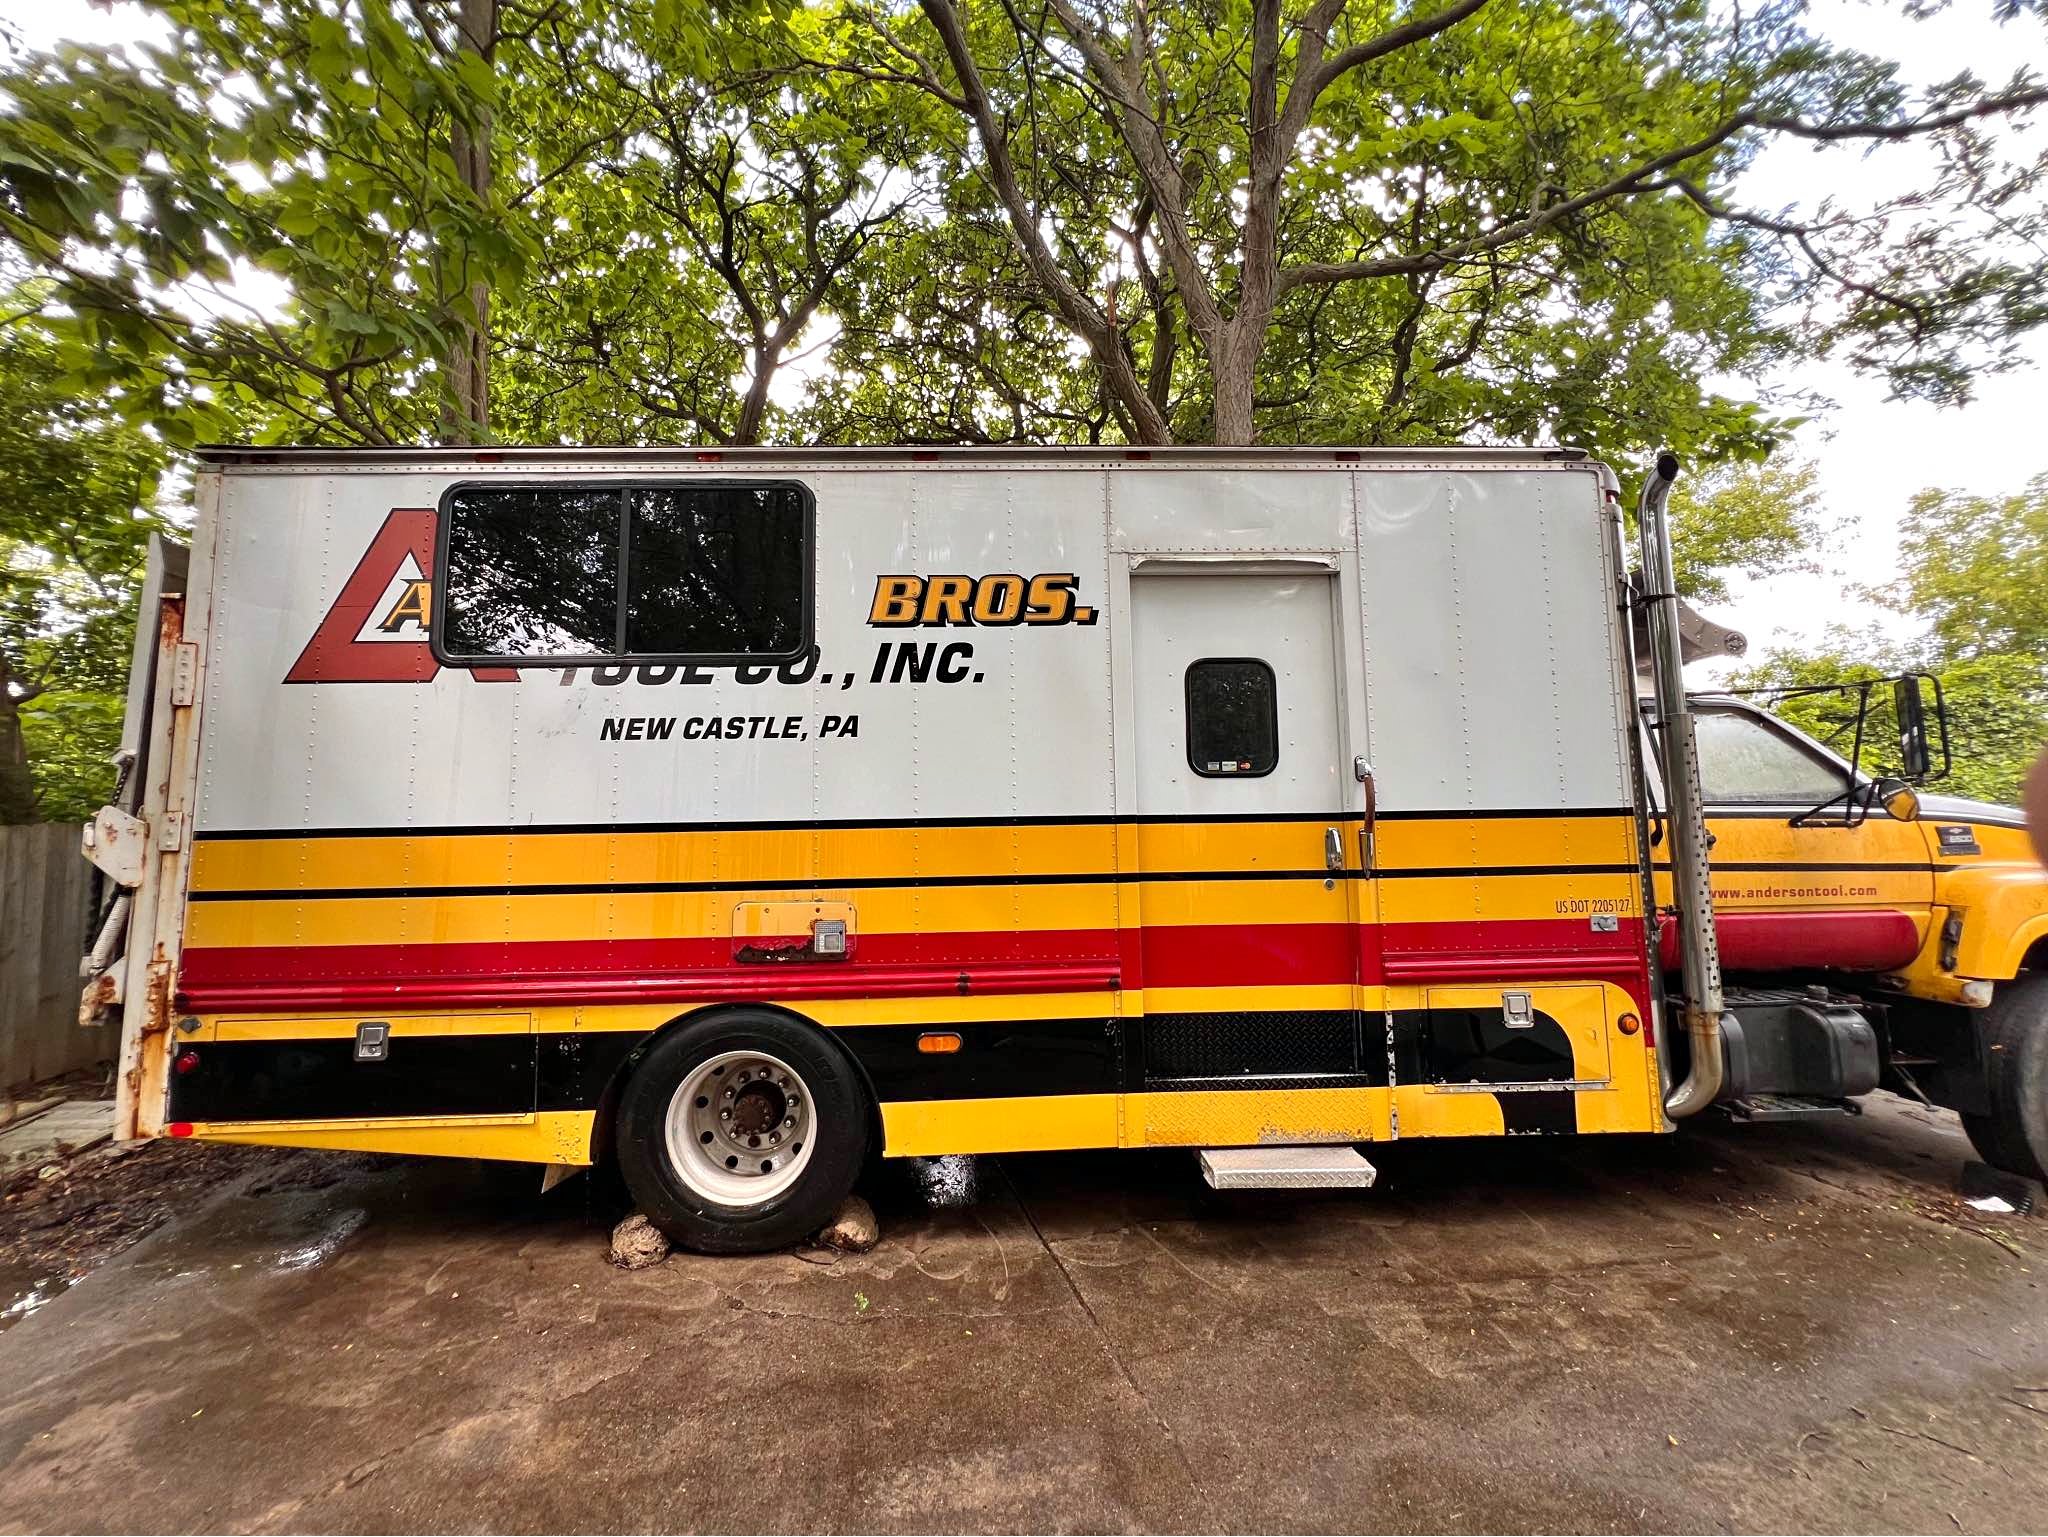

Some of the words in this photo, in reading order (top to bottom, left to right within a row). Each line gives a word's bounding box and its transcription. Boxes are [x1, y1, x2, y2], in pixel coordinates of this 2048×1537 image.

[866, 573, 1099, 628] BROS.
[870, 642, 985, 684] INC.
[600, 718, 676, 740] NEW
[683, 716, 808, 742] CASTLE,
[819, 715, 859, 738] PA
[1711, 885, 1877, 898] www.andersontool.com
[1555, 900, 1569, 914] US
[1570, 900, 1590, 913] DOT
[1592, 899, 1630, 912] 2205127
